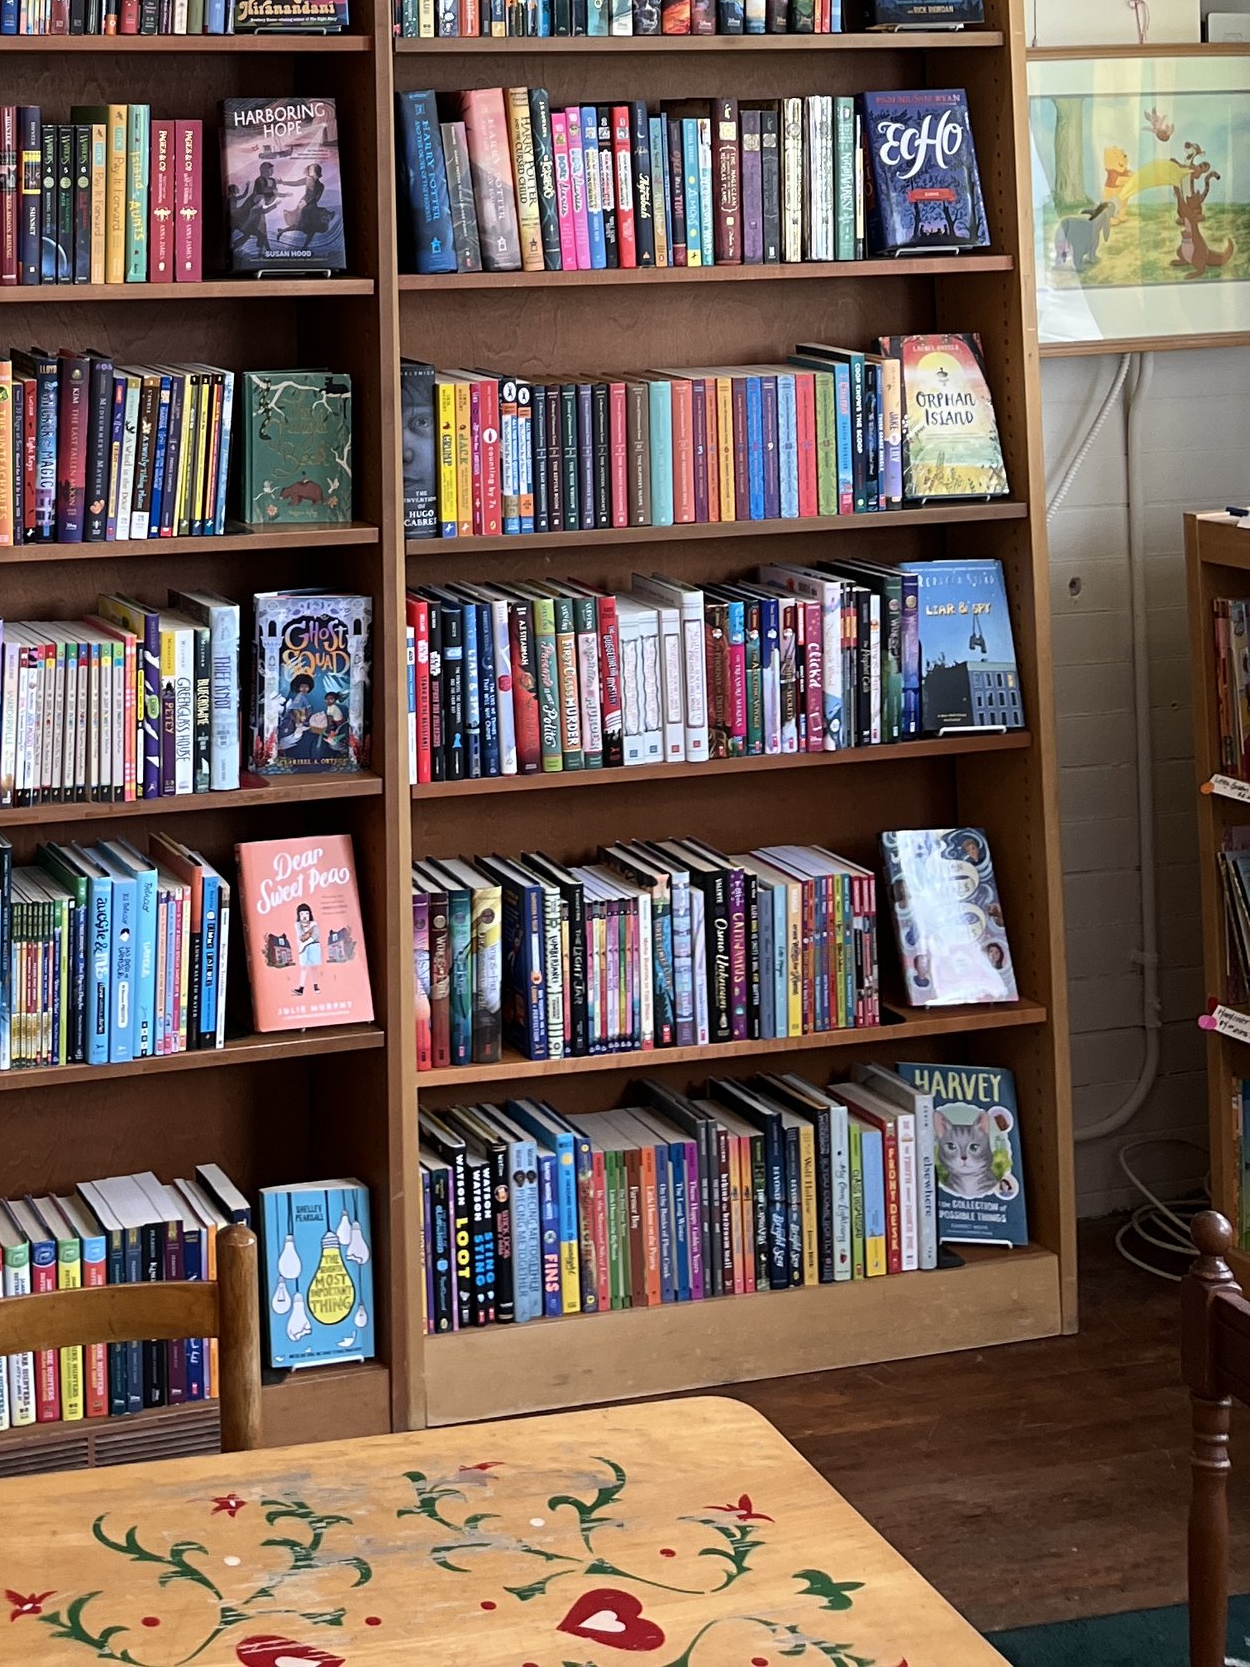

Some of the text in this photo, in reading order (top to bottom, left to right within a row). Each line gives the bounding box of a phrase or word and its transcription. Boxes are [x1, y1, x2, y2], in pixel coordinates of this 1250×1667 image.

[238, 0, 336, 22] Hiranandani
[234, 102, 326, 127] HARBORING
[263, 120, 302, 138] HOPE
[877, 110, 964, 180] ECHO
[265, 250, 288, 258] SUSAN
[916, 391, 977, 408] ORPHAN
[925, 408, 974, 427] ISLAND
[925, 602, 992, 616] LIAR & SPY
[282, 648, 350, 680] SQUAD
[273, 846, 323, 881] Dear
[257, 866, 350, 915] Sweet Pea
[277, 1000, 353, 1016] JULIE MURPHY
[914, 1069, 1001, 1103] HARVEY
[923, 1156, 932, 1217] elsewhere
[295, 1204, 323, 1214] SHELLEY
[952, 1199, 999, 1212] COLLECTION
[295, 1212, 324, 1222] PEARSALL
[455, 1154, 470, 1279] WATSON LOOT
[939, 1210, 1007, 1223] POSSIBLE THINGS
[315, 1274, 347, 1286] MOST
[544, 1253, 560, 1293] FINS
[310, 1298, 351, 1313] THING
